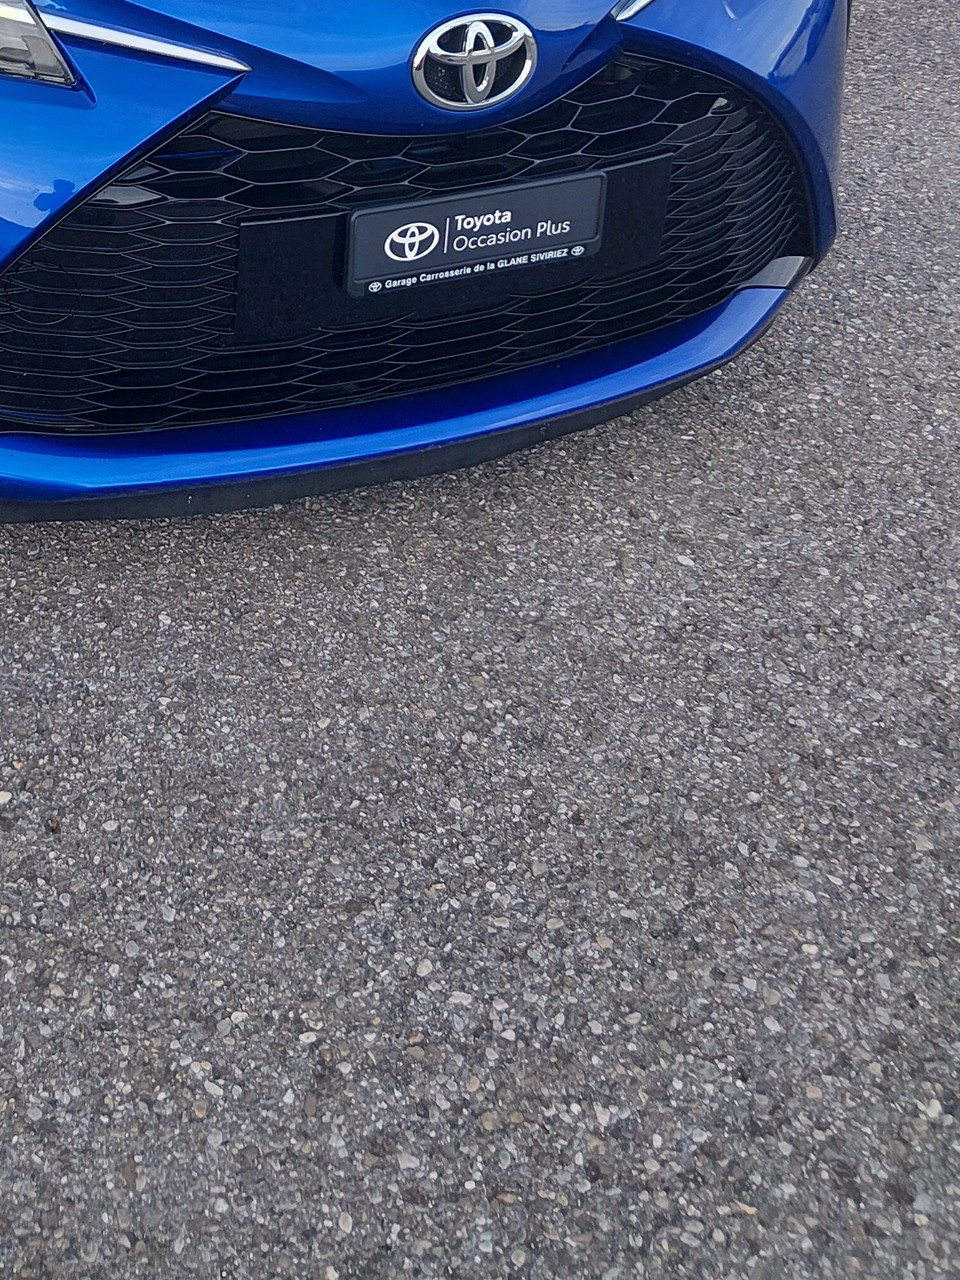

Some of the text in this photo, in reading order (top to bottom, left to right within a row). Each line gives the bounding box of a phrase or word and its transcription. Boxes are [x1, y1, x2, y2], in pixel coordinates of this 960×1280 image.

[453, 219, 571, 251] Occasion Plus
[454, 209, 512, 232] Toyota
[384, 248, 570, 289] Garage Carrosserie de la GLANE SIVIRIEZ
